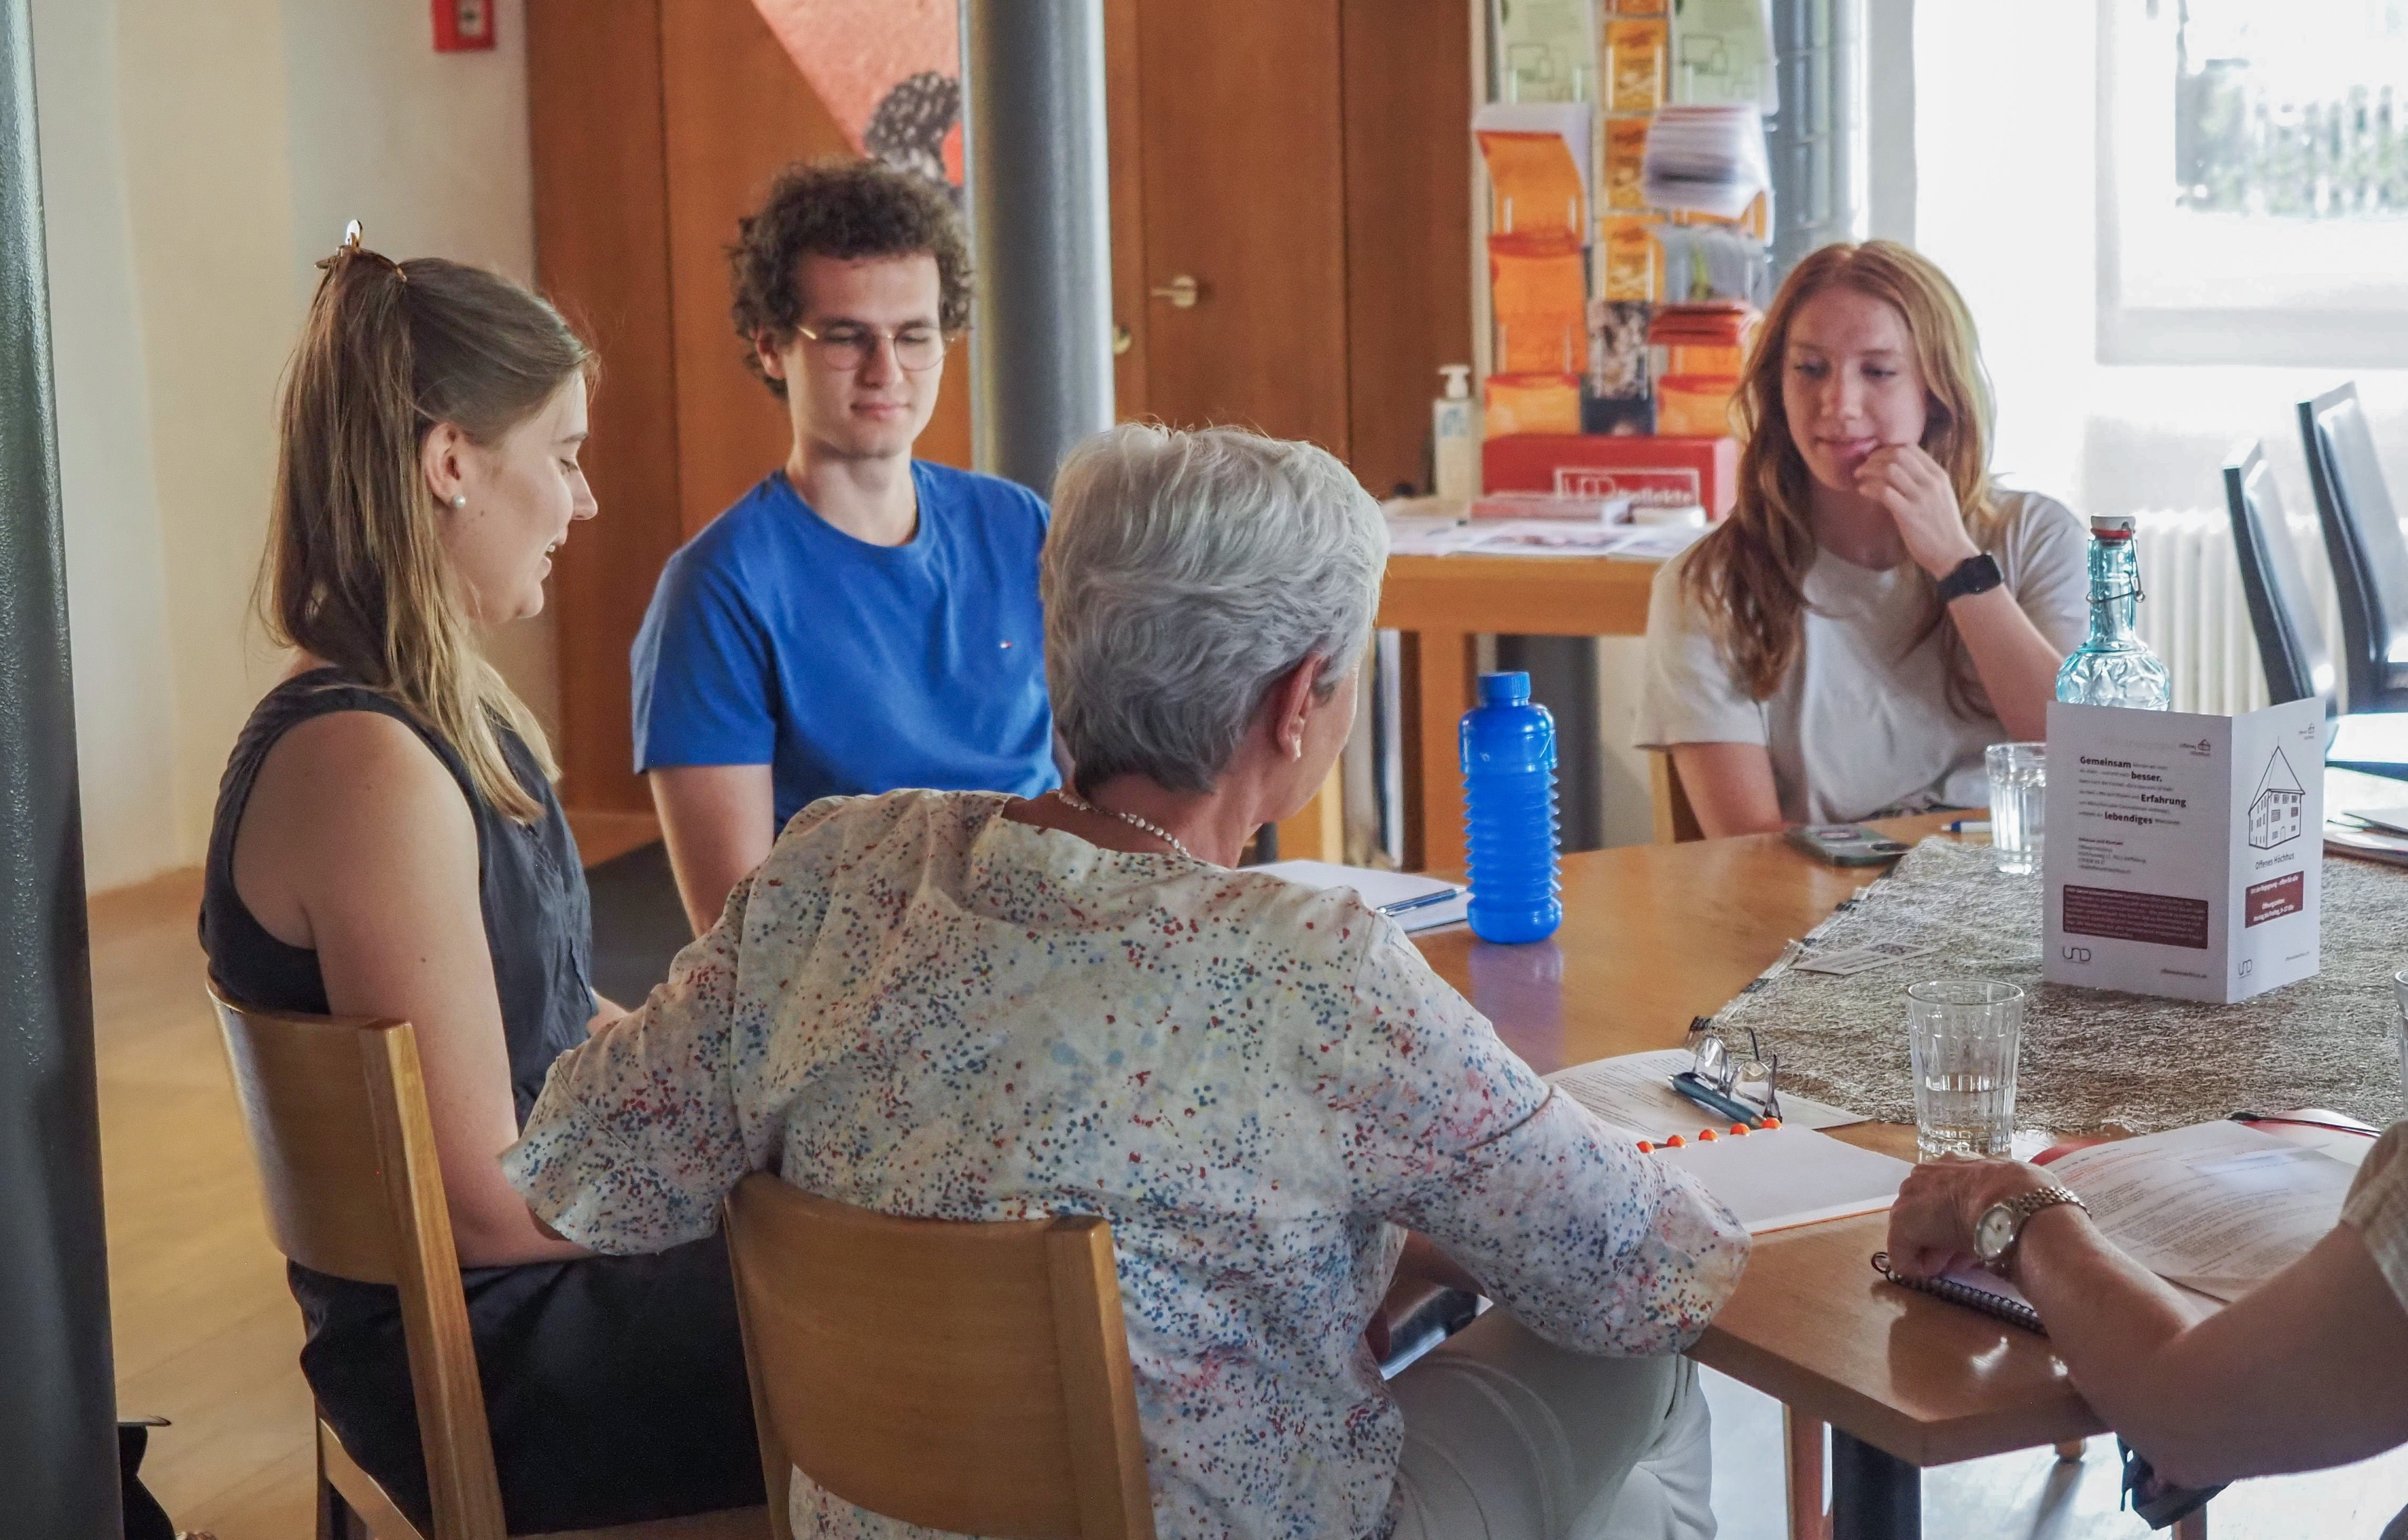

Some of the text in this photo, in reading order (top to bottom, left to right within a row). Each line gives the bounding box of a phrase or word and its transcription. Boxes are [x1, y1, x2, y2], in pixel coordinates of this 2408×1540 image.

[2080, 756, 2132, 768] Gemeinsam
[2131, 771, 2162, 782] besser.
[2141, 794, 2187, 808] Erfahrung
[2104, 812, 2153, 825] lebendiges
[2255, 859, 2273, 870] Offenes
[2062, 946, 2091, 962] UND
[2238, 959, 2252, 976] UND
